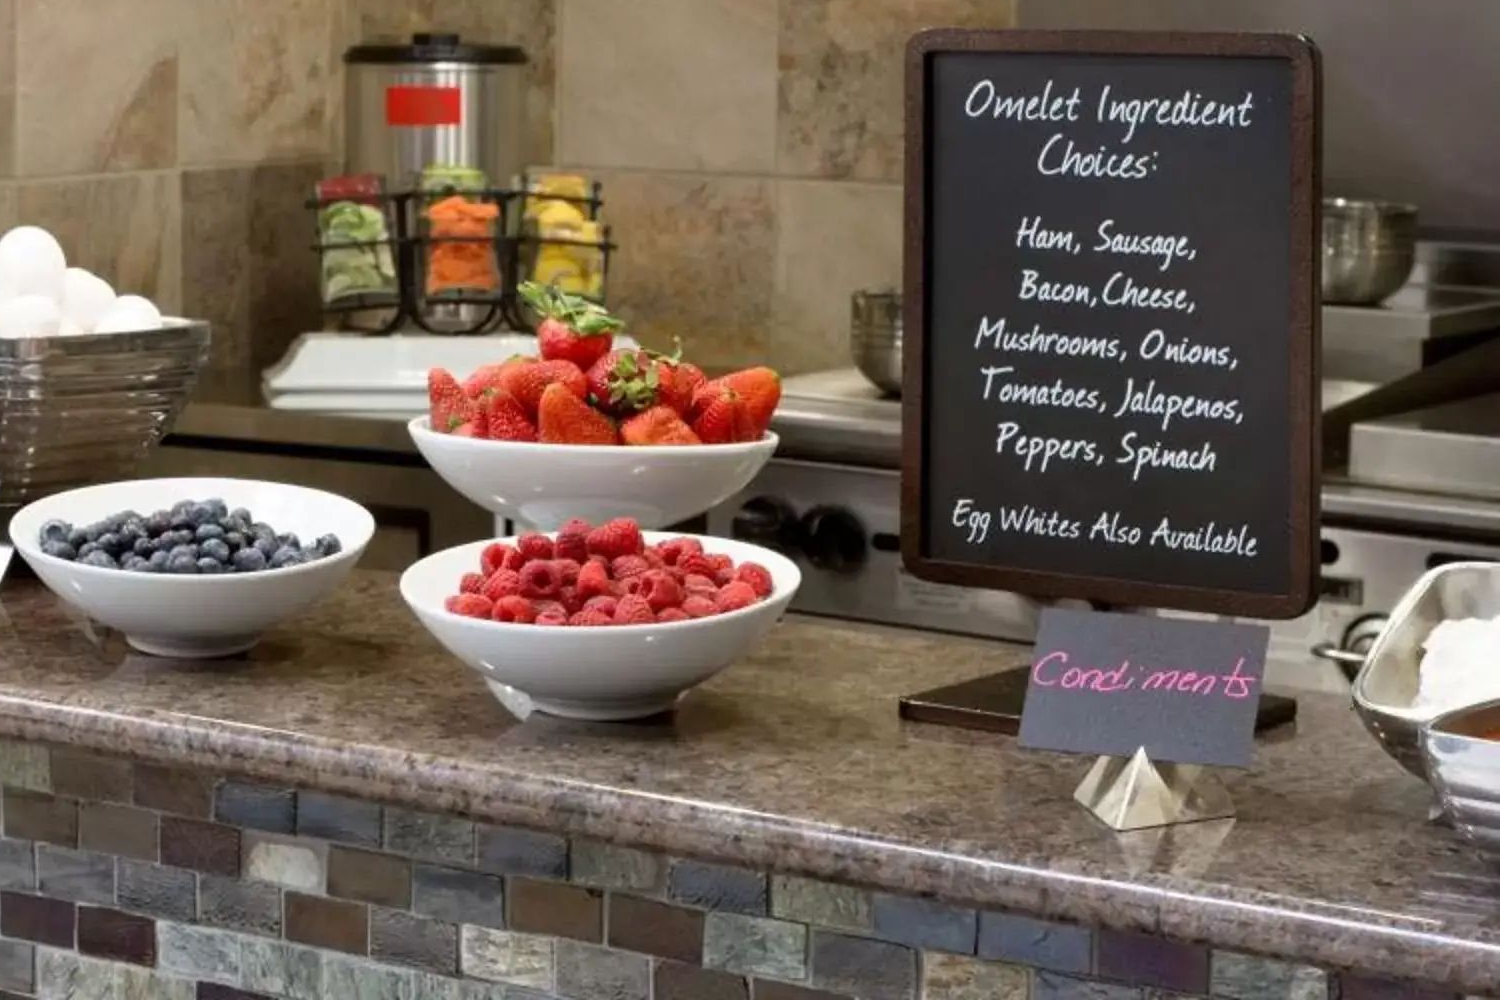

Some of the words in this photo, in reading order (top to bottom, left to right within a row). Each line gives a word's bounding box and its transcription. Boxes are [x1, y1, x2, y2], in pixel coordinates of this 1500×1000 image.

[964, 78, 1081, 123] Omelet
[1097, 84, 1254, 144] Ingredient
[1036, 132, 1158, 180] Choices:
[1016, 215, 1082, 255] Ham,
[1094, 220, 1198, 272] Sausage,
[973, 316, 1128, 362] Mushrooms,
[1138, 329, 1240, 369] Onions,
[980, 366, 1108, 414] Tomatoes,
[1114, 378, 1244, 431] Jalapenos,
[995, 421, 1105, 473] Peppers,
[1116, 432, 1216, 480] Spinach
[952, 499, 991, 544] Egg
[999, 505, 1081, 539] Whites
[1089, 515, 1142, 546] Also
[1149, 517, 1258, 558] Available
[1032, 650, 1257, 698] Condiments
